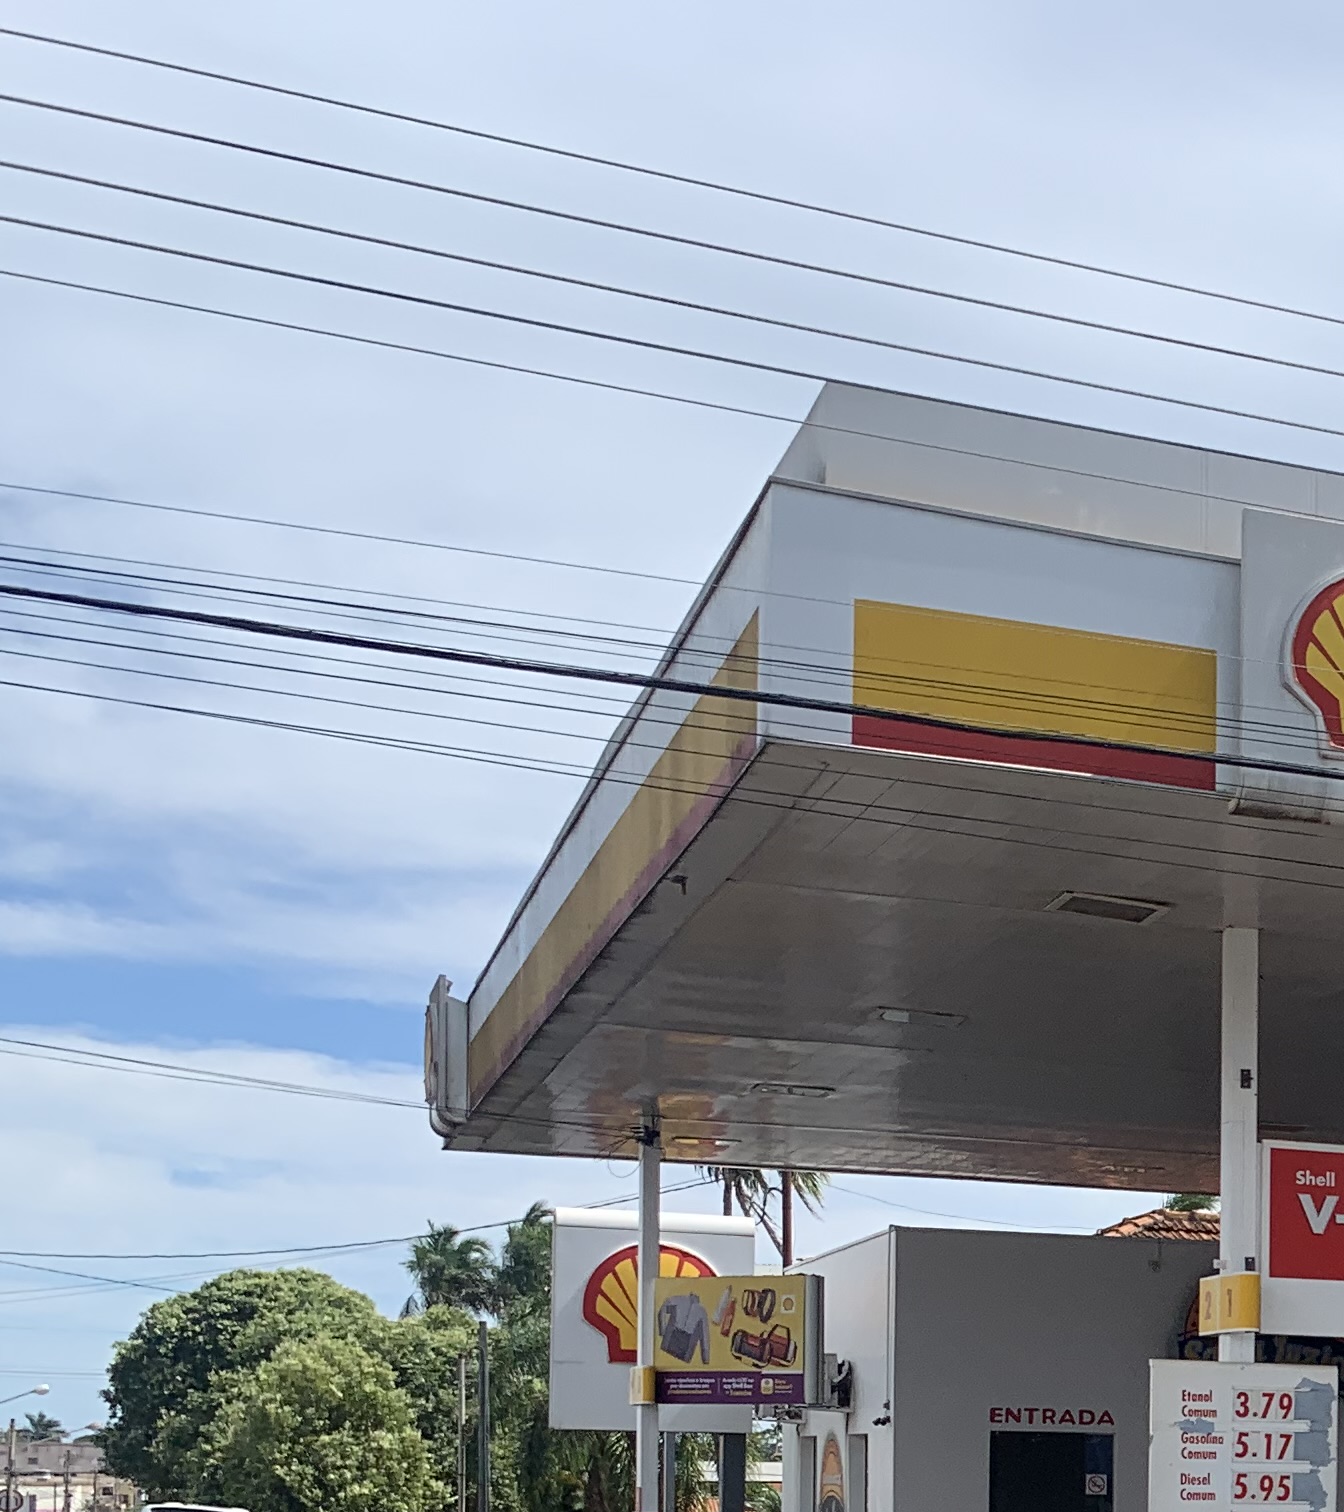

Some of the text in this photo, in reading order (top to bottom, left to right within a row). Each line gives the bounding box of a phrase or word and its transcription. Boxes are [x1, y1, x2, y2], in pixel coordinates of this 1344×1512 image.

[1295, 1169, 1336, 1188] Shell
[1203, 1290, 1213, 1321] 2
[1225, 1288, 1233, 1318] 1
[1181, 1389, 1213, 1403] Etanol
[1235, 1391, 1293, 1419] 3.79
[989, 1407, 1115, 1426] ENTRADA
[1181, 1405, 1218, 1418] Comum
[1181, 1431, 1225, 1445] Gasolina
[1234, 1432, 1293, 1460] 5.17
[1181, 1447, 1217, 1460] Comum
[1180, 1472, 1211, 1486] Diesel
[1233, 1473, 1291, 1501] 5.95
[1180, 1489, 1216, 1501] Comum
